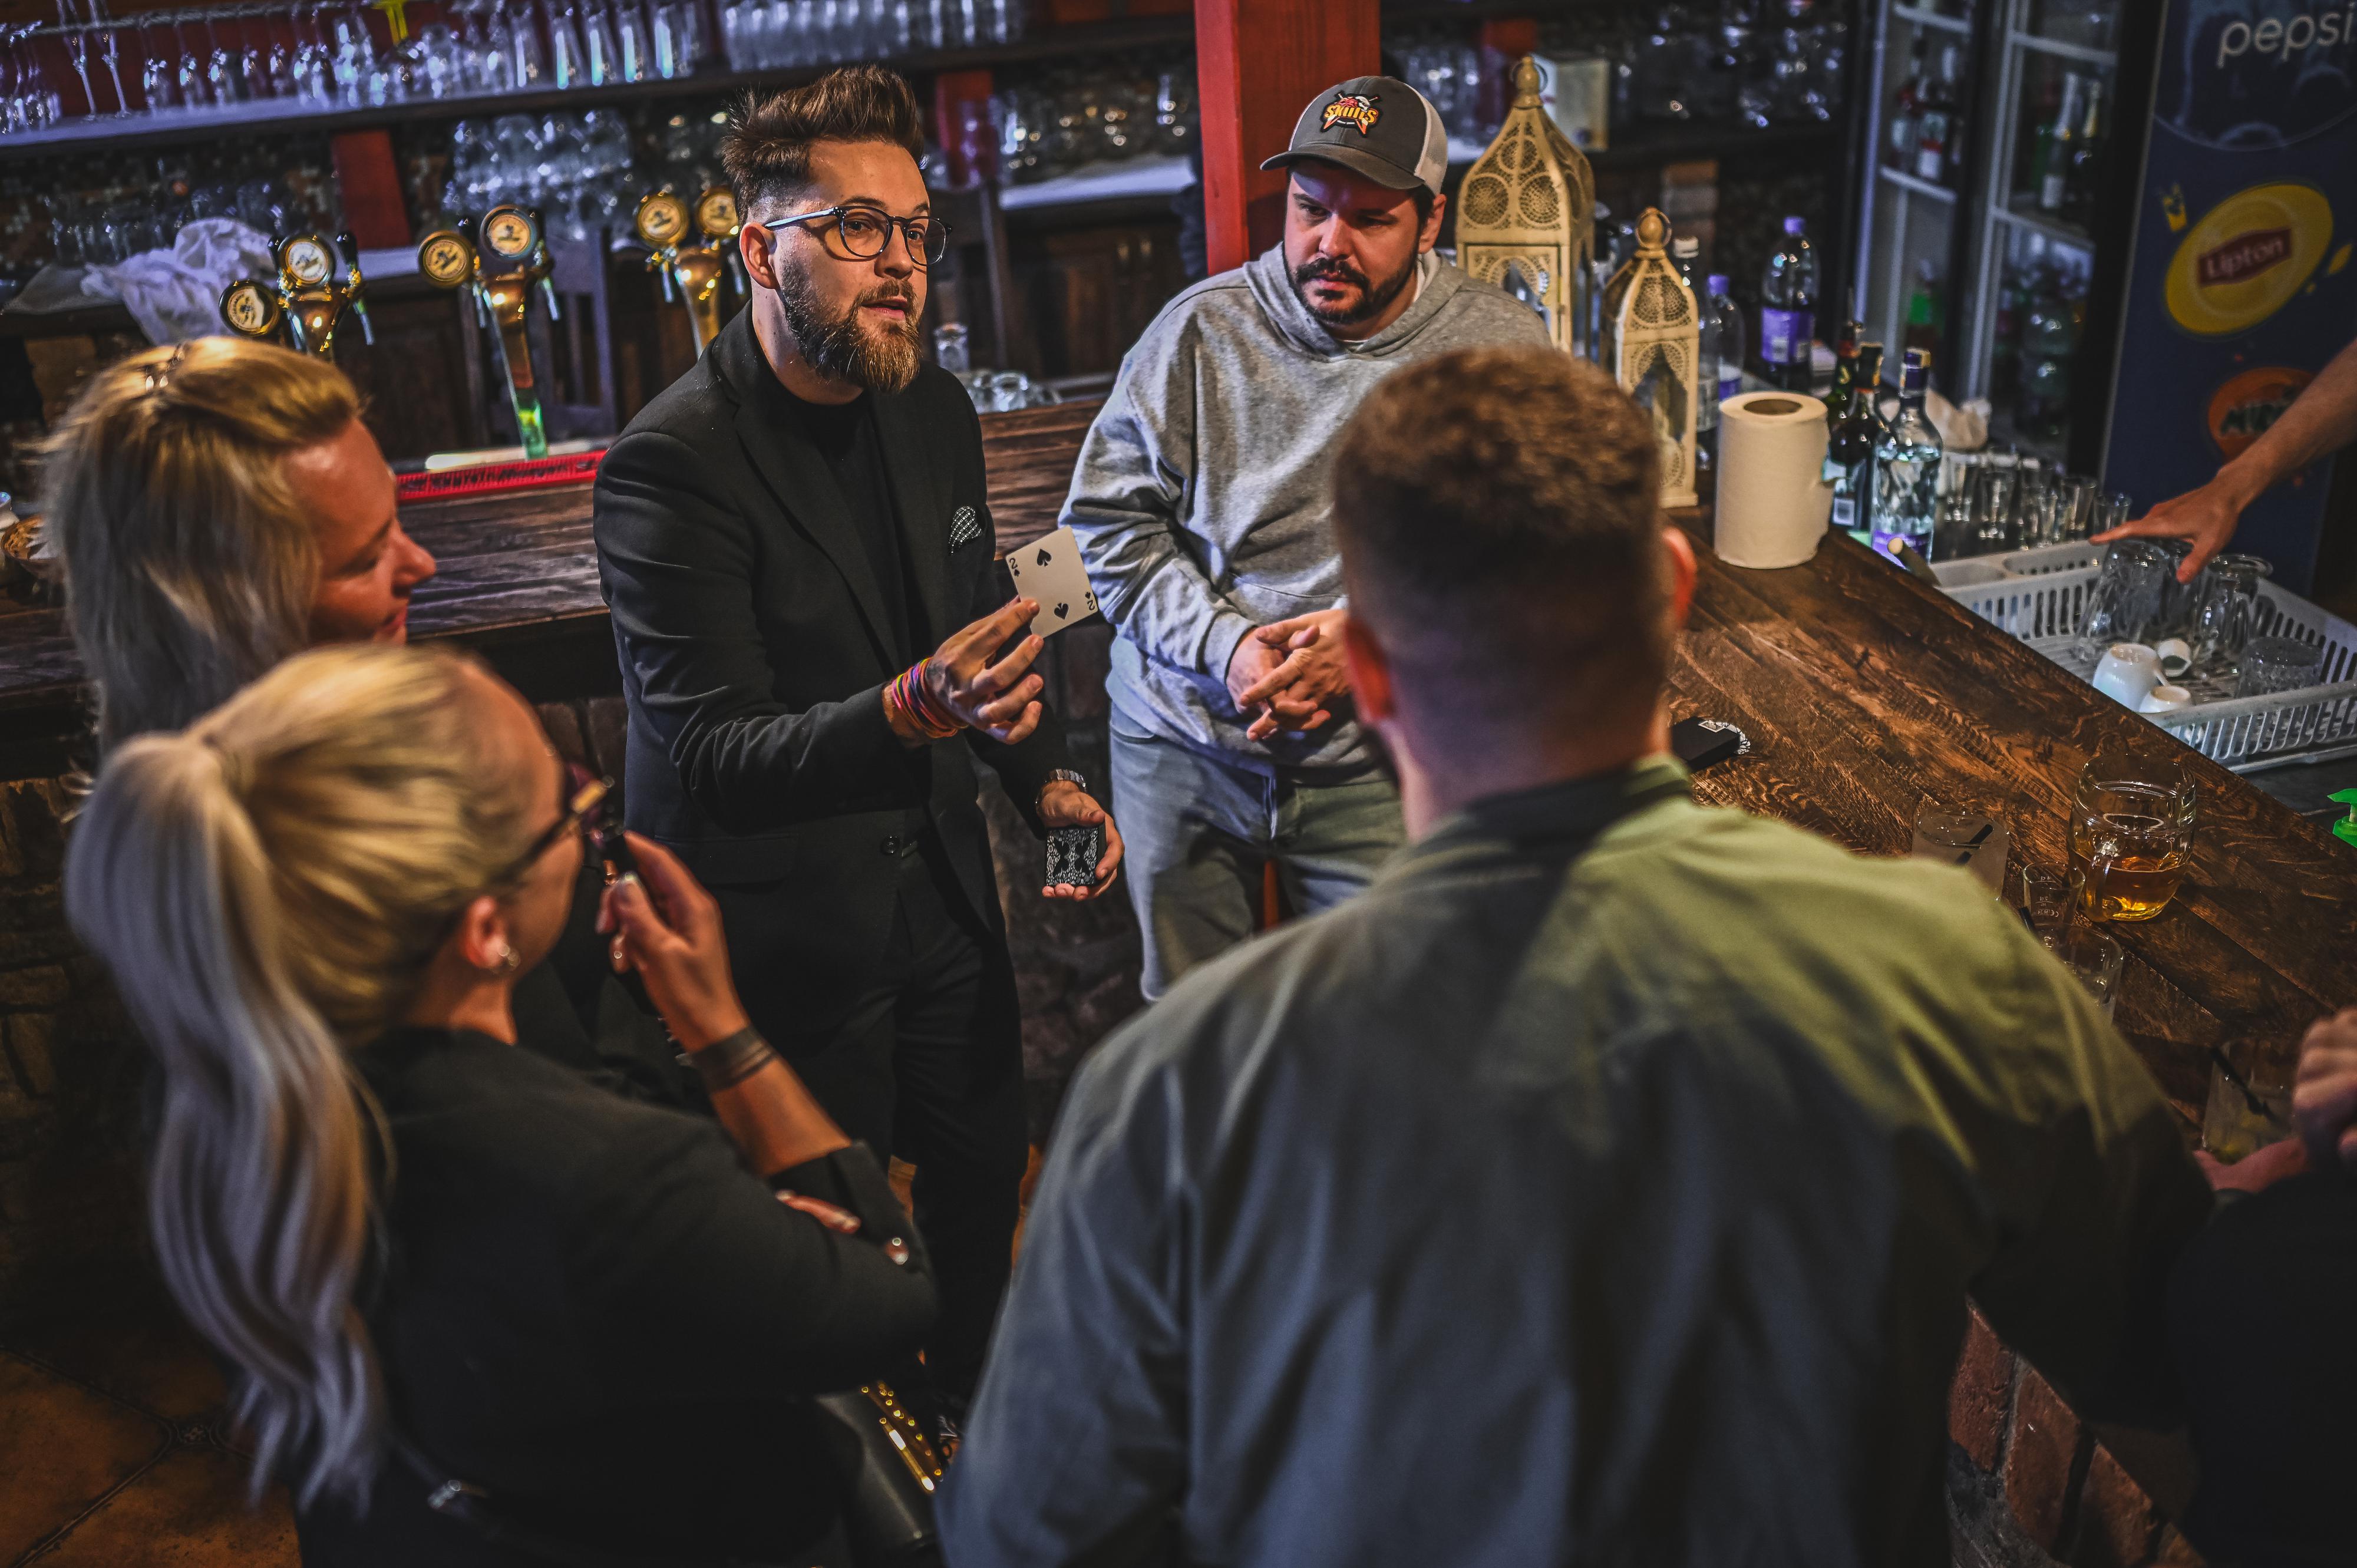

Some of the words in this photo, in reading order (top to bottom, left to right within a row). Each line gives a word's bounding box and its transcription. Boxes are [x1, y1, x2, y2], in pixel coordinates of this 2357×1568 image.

[2217, 1, 2355, 69] pepsi
[2206, 237, 2284, 278] Lipton
[1009, 557, 1018, 569] 2
[1087, 600, 1095, 610] 2
